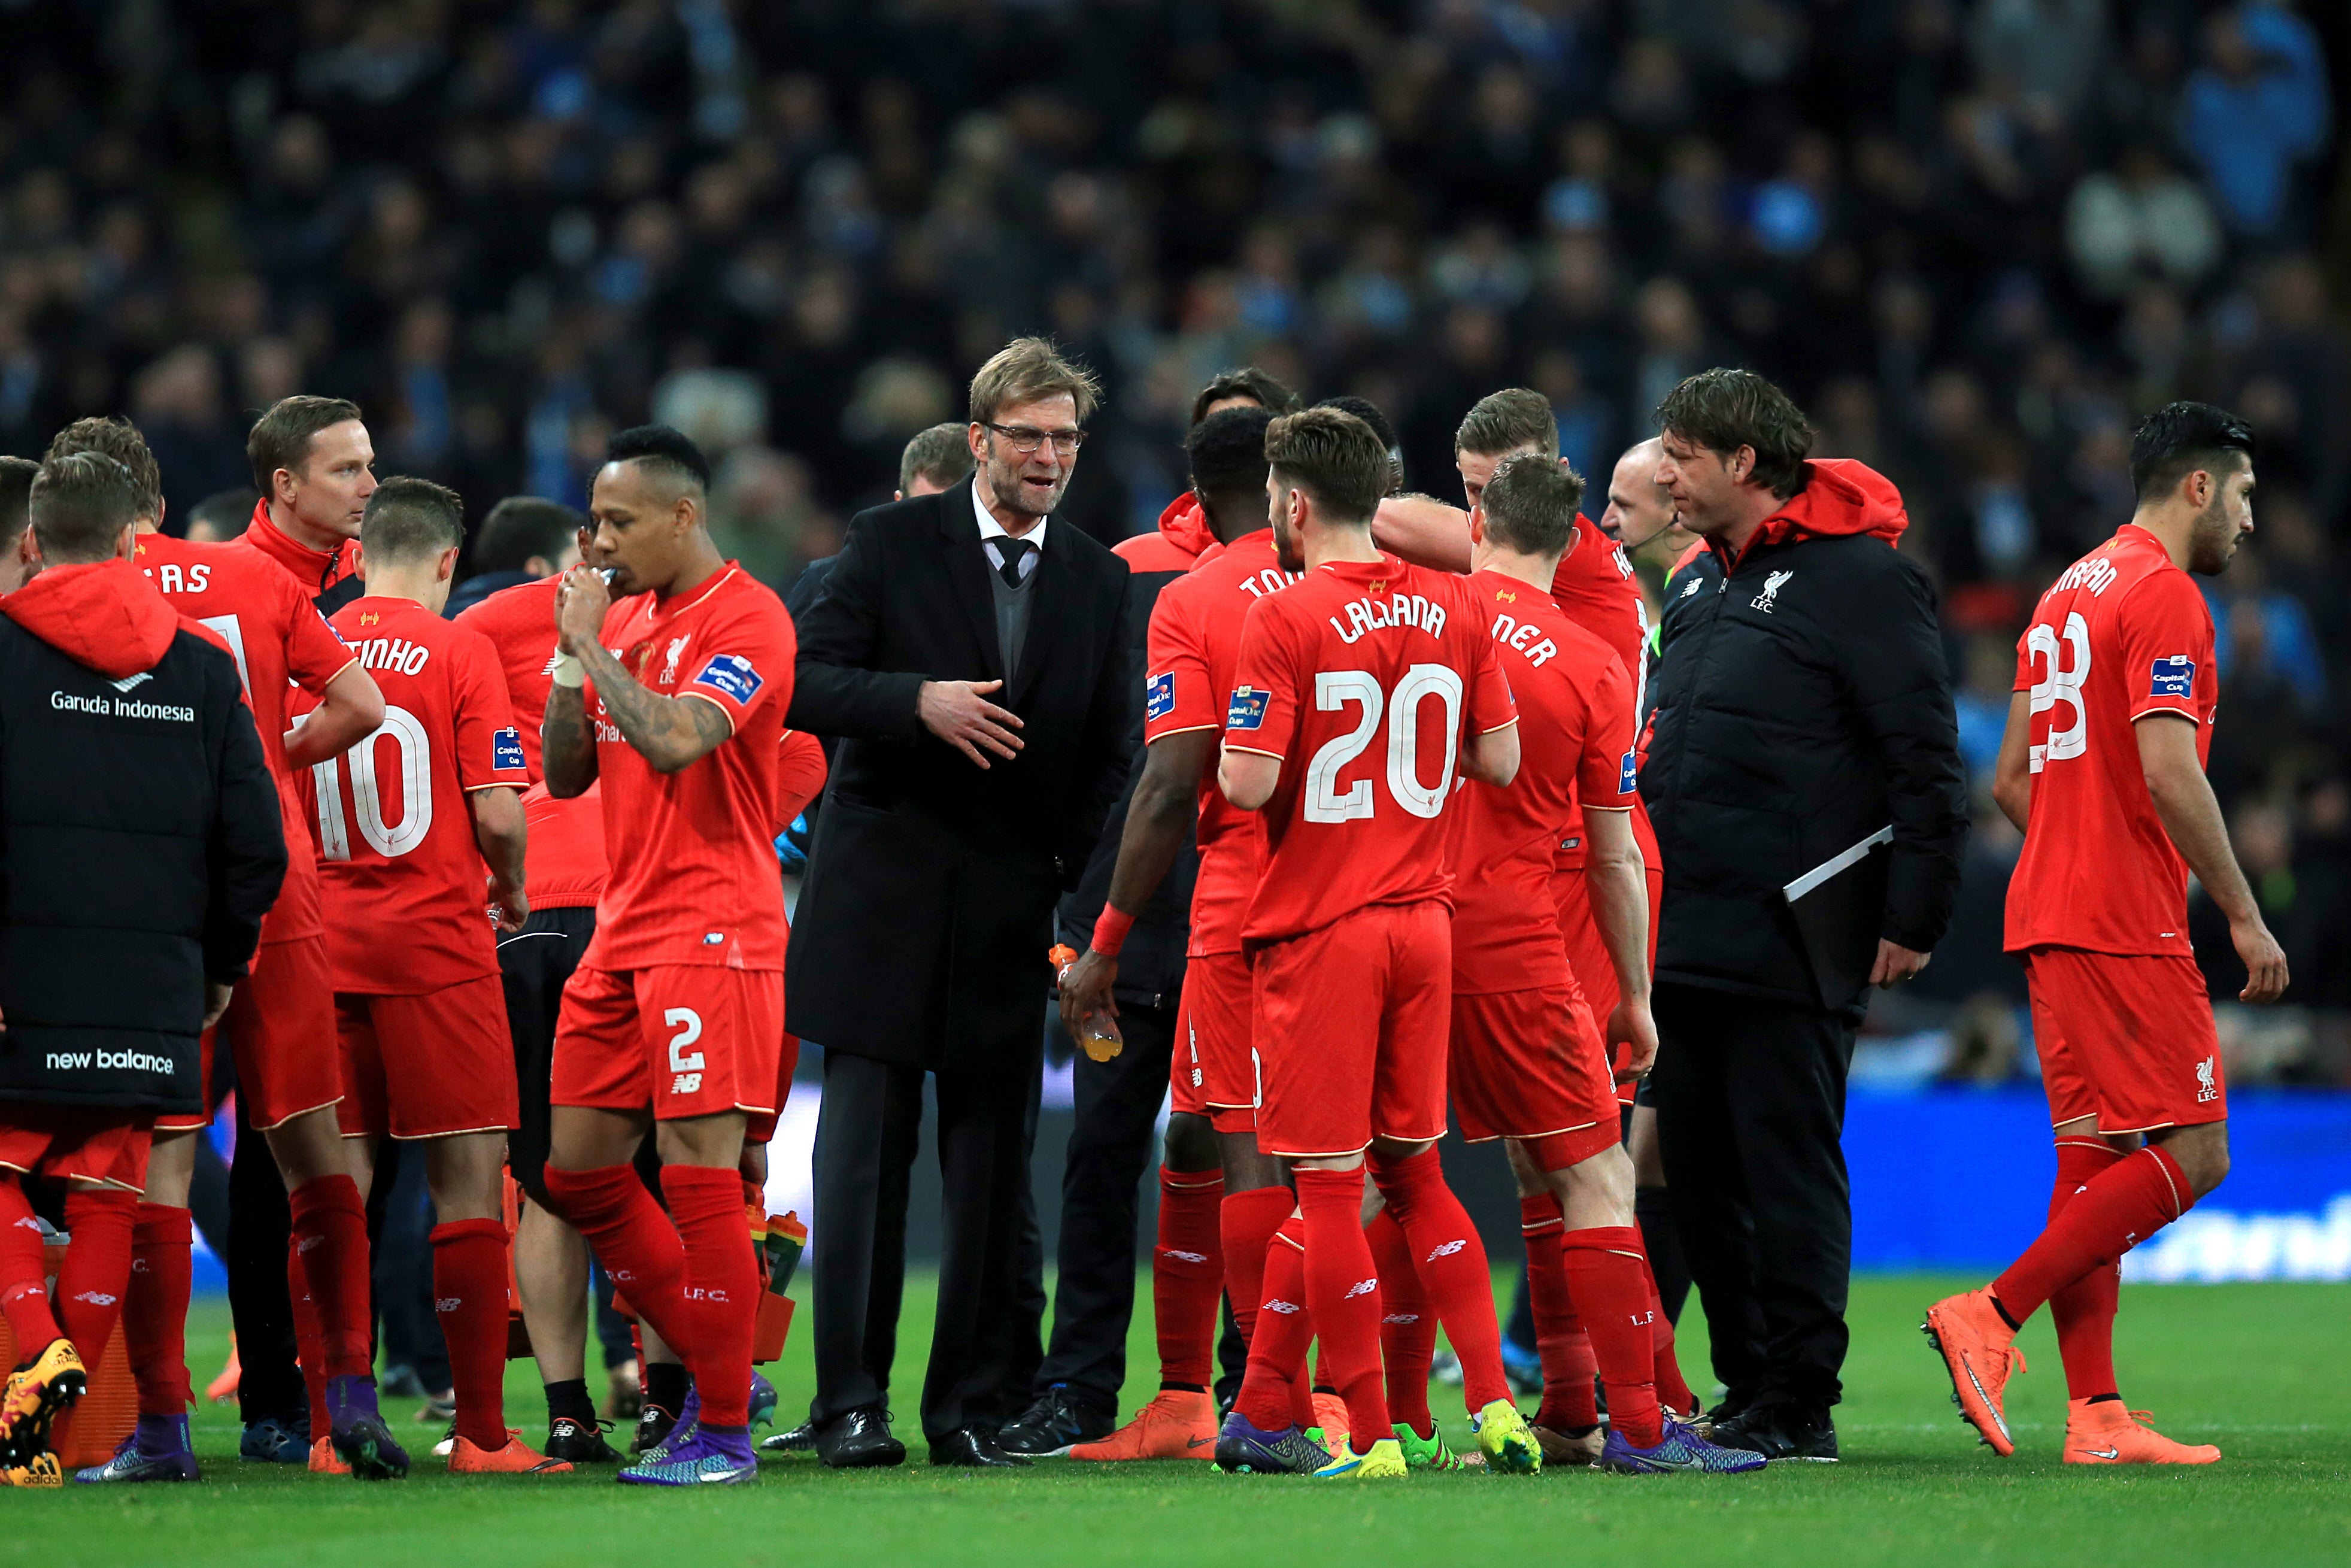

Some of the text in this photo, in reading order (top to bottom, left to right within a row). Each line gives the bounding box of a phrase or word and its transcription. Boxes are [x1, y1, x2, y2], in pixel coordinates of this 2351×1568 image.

[1329, 593, 1447, 644] LALLANA
[51, 690, 194, 722] Garuda Indonesia
[1228, 716, 1244, 726] Cup
[509, 756, 520, 765] Cup
[1304, 663, 1463, 824] 20
[292, 705, 433, 862] 10
[664, 1007, 706, 1073] 2
[46, 1048, 174, 1075] new balance
